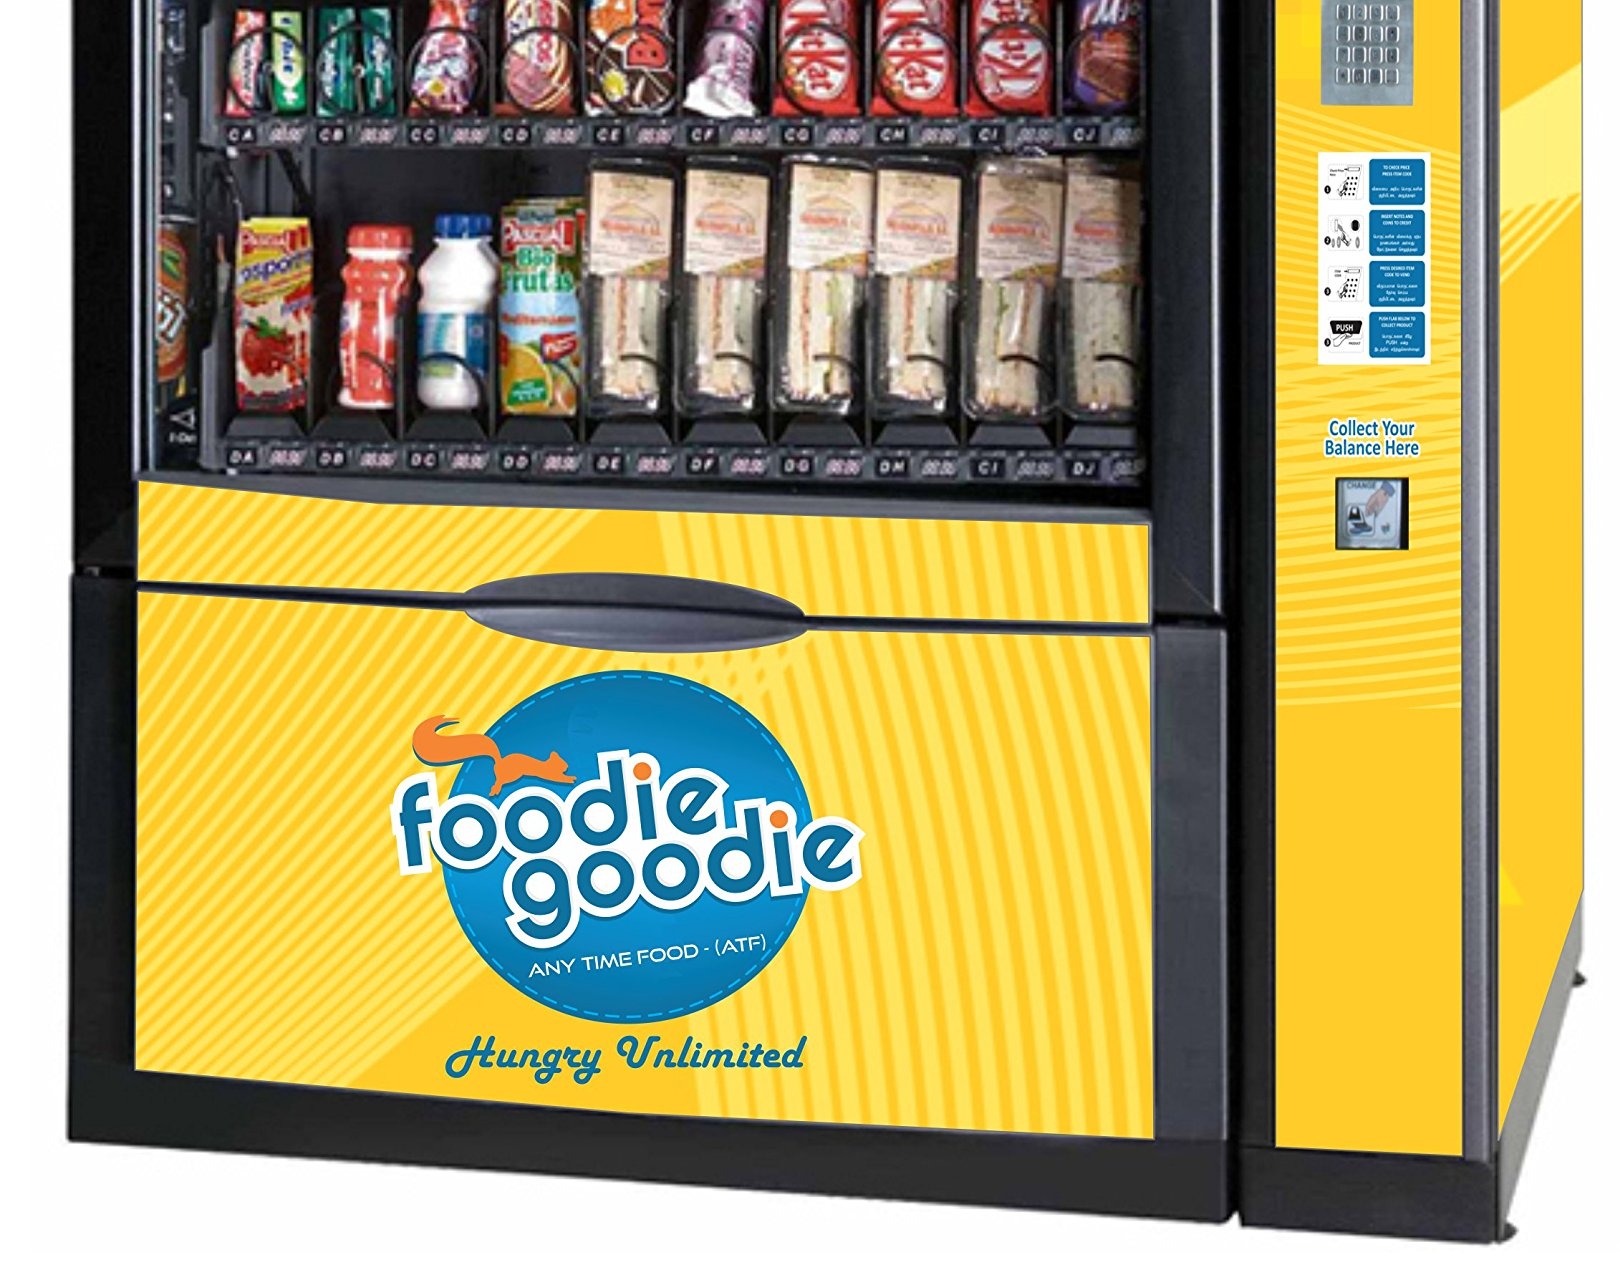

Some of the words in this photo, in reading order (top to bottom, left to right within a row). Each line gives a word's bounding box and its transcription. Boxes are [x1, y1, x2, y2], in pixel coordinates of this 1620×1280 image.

[1336, 324, 1354, 332] PUSH
[1325, 440, 1381, 455] Balance
[1385, 440, 1419, 455] Here
[1329, 420, 1378, 436] Collect
[1382, 421, 1415, 436] Your
[396, 757, 722, 870] foodie
[508, 805, 857, 932] goodie
[528, 957, 574, 979] ANY
[580, 951, 632, 973] TIME
[637, 943, 699, 966] FOOD
[714, 932, 767, 959] (ATF)
[445, 1035, 602, 1085] Hungry
[616, 1035, 808, 1070] Unlimited
